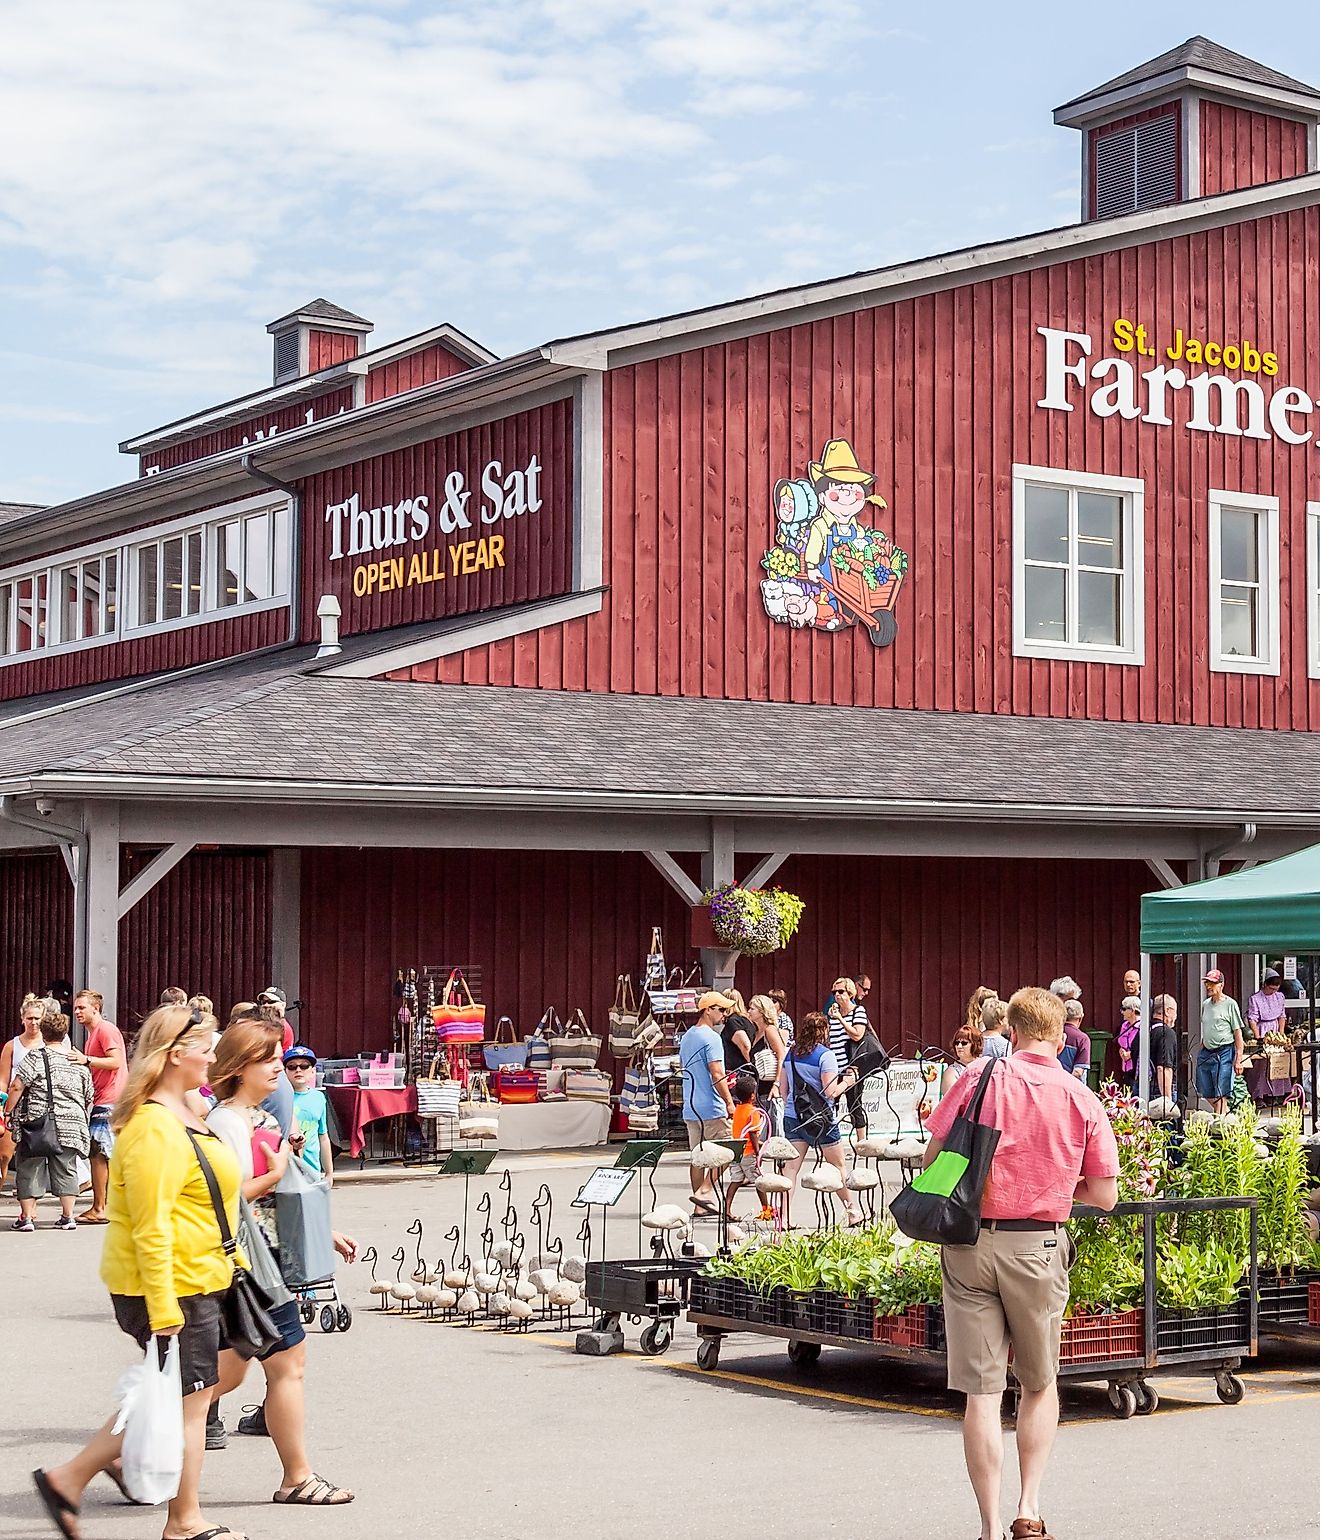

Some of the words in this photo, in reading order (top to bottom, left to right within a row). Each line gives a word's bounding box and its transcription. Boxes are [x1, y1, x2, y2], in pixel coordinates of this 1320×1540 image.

[1112, 318, 1156, 357] St.
[1166, 329, 1279, 376] Jacobs
[325, 492, 430, 561] Thurs
[439, 470, 473, 534] &
[480, 454, 543, 525] Sat
[353, 556, 404, 598] OPEN
[406, 548, 446, 587] ALL
[448, 534, 506, 578] YEAR
[895, 1081, 917, 1094] Honey
